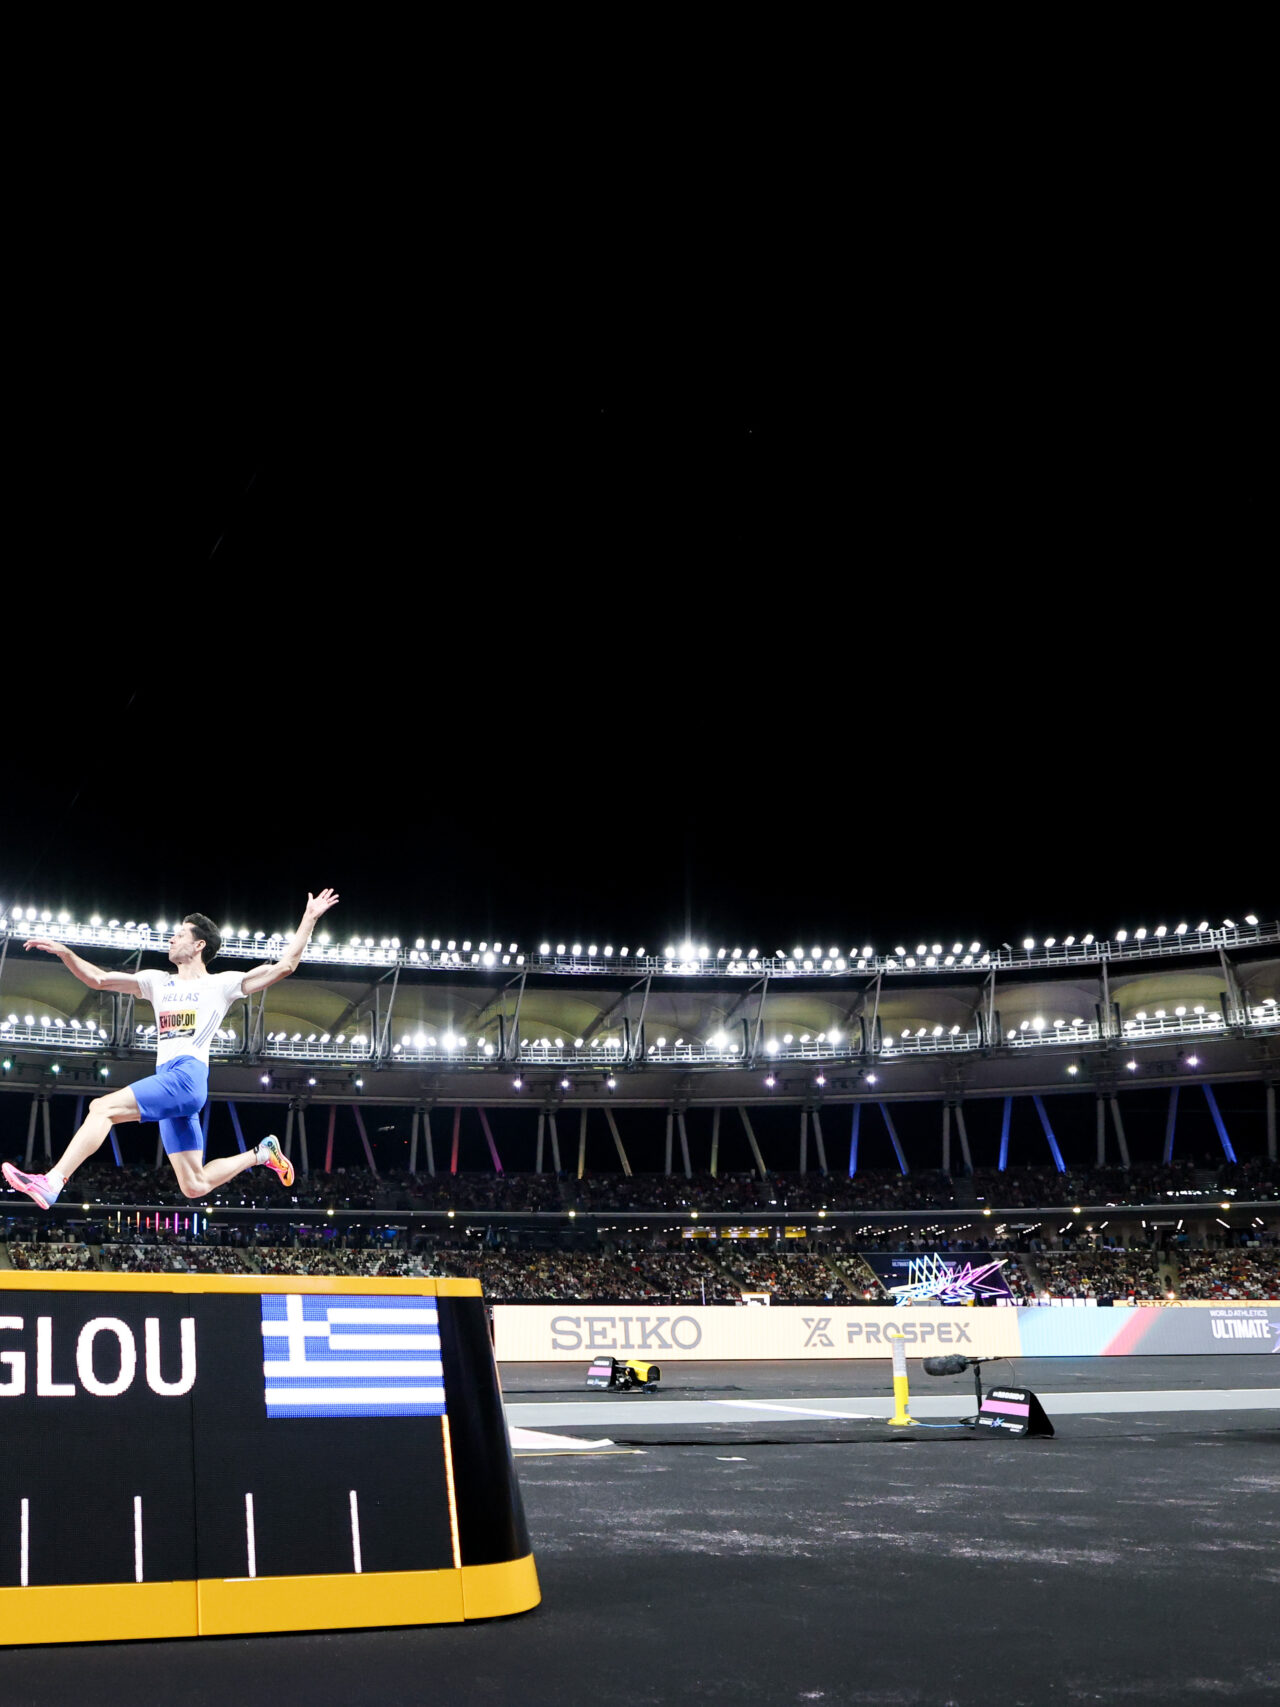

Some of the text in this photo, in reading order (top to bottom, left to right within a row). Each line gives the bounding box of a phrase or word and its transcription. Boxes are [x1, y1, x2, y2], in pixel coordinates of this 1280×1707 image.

[162, 993, 200, 1003] HELLAS
[160, 1013, 195, 1029] ENTOGLOU
[1209, 1309, 1233, 1317] WORLD
[551, 1316, 972, 1350] SEIKO PROSPEX
[1211, 1319, 1271, 1339] ULTIMATE
